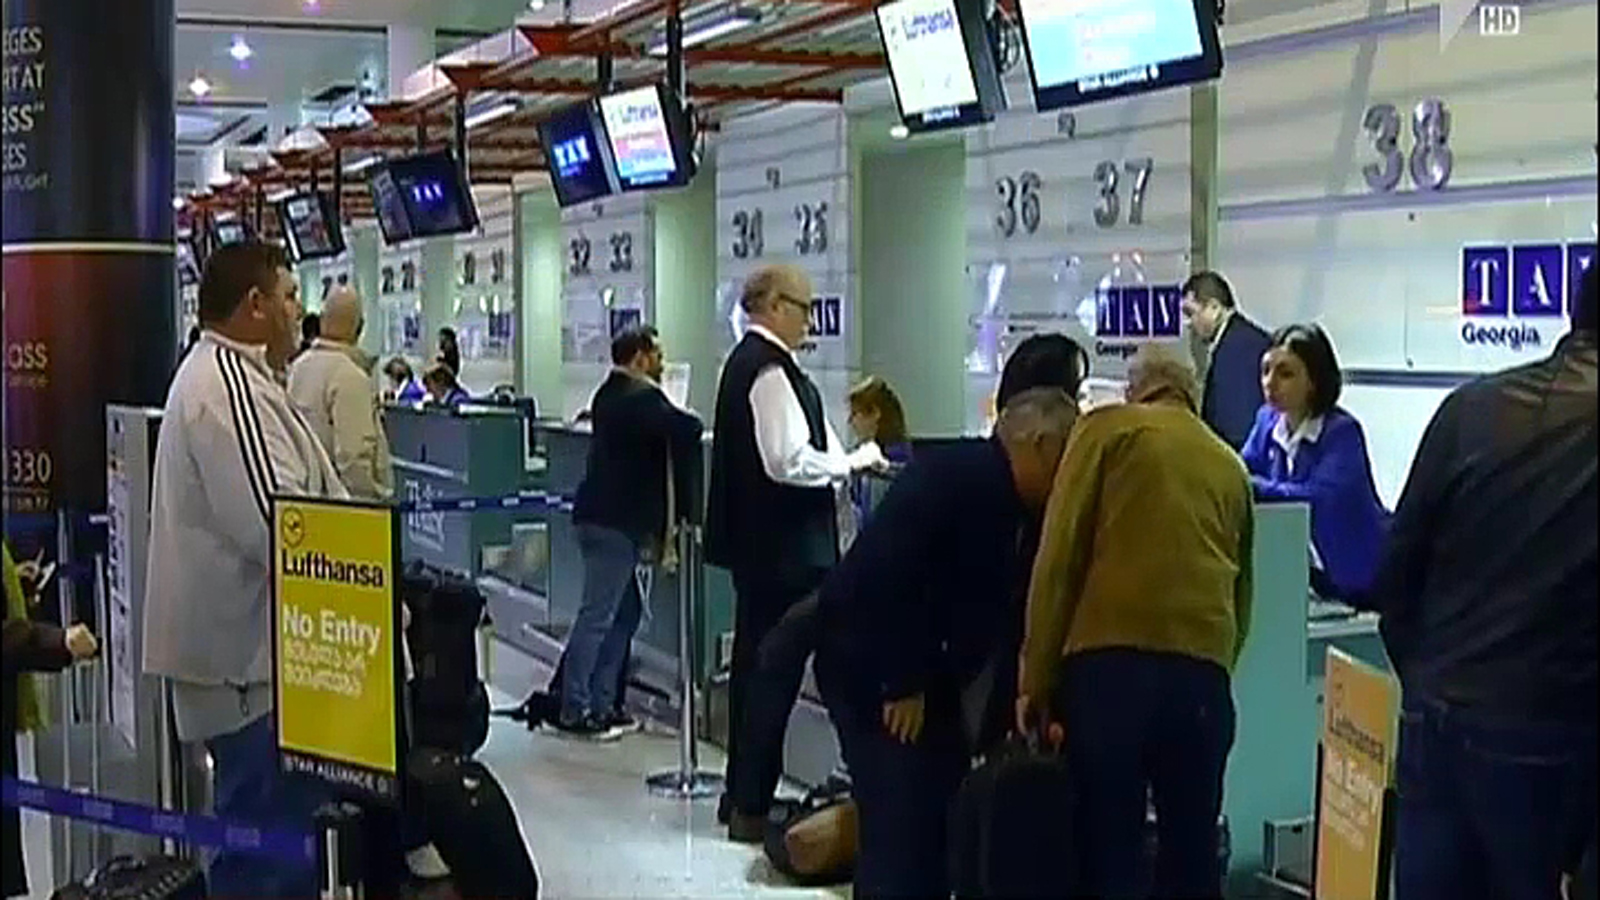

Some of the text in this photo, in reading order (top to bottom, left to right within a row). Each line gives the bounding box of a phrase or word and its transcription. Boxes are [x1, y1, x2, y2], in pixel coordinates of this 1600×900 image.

[1363, 99, 1452, 191] 38
[996, 170, 1042, 238] 36
[1093, 157, 1154, 228] 37
[610, 231, 633, 272] 33
[732, 208, 764, 259] 34
[794, 202, 828, 255] 35
[1461, 321, 1542, 351] Georgia
[281, 548, 384, 589] Lufthansa
[282, 603, 313, 639] No
[320, 609, 381, 656] Entry
